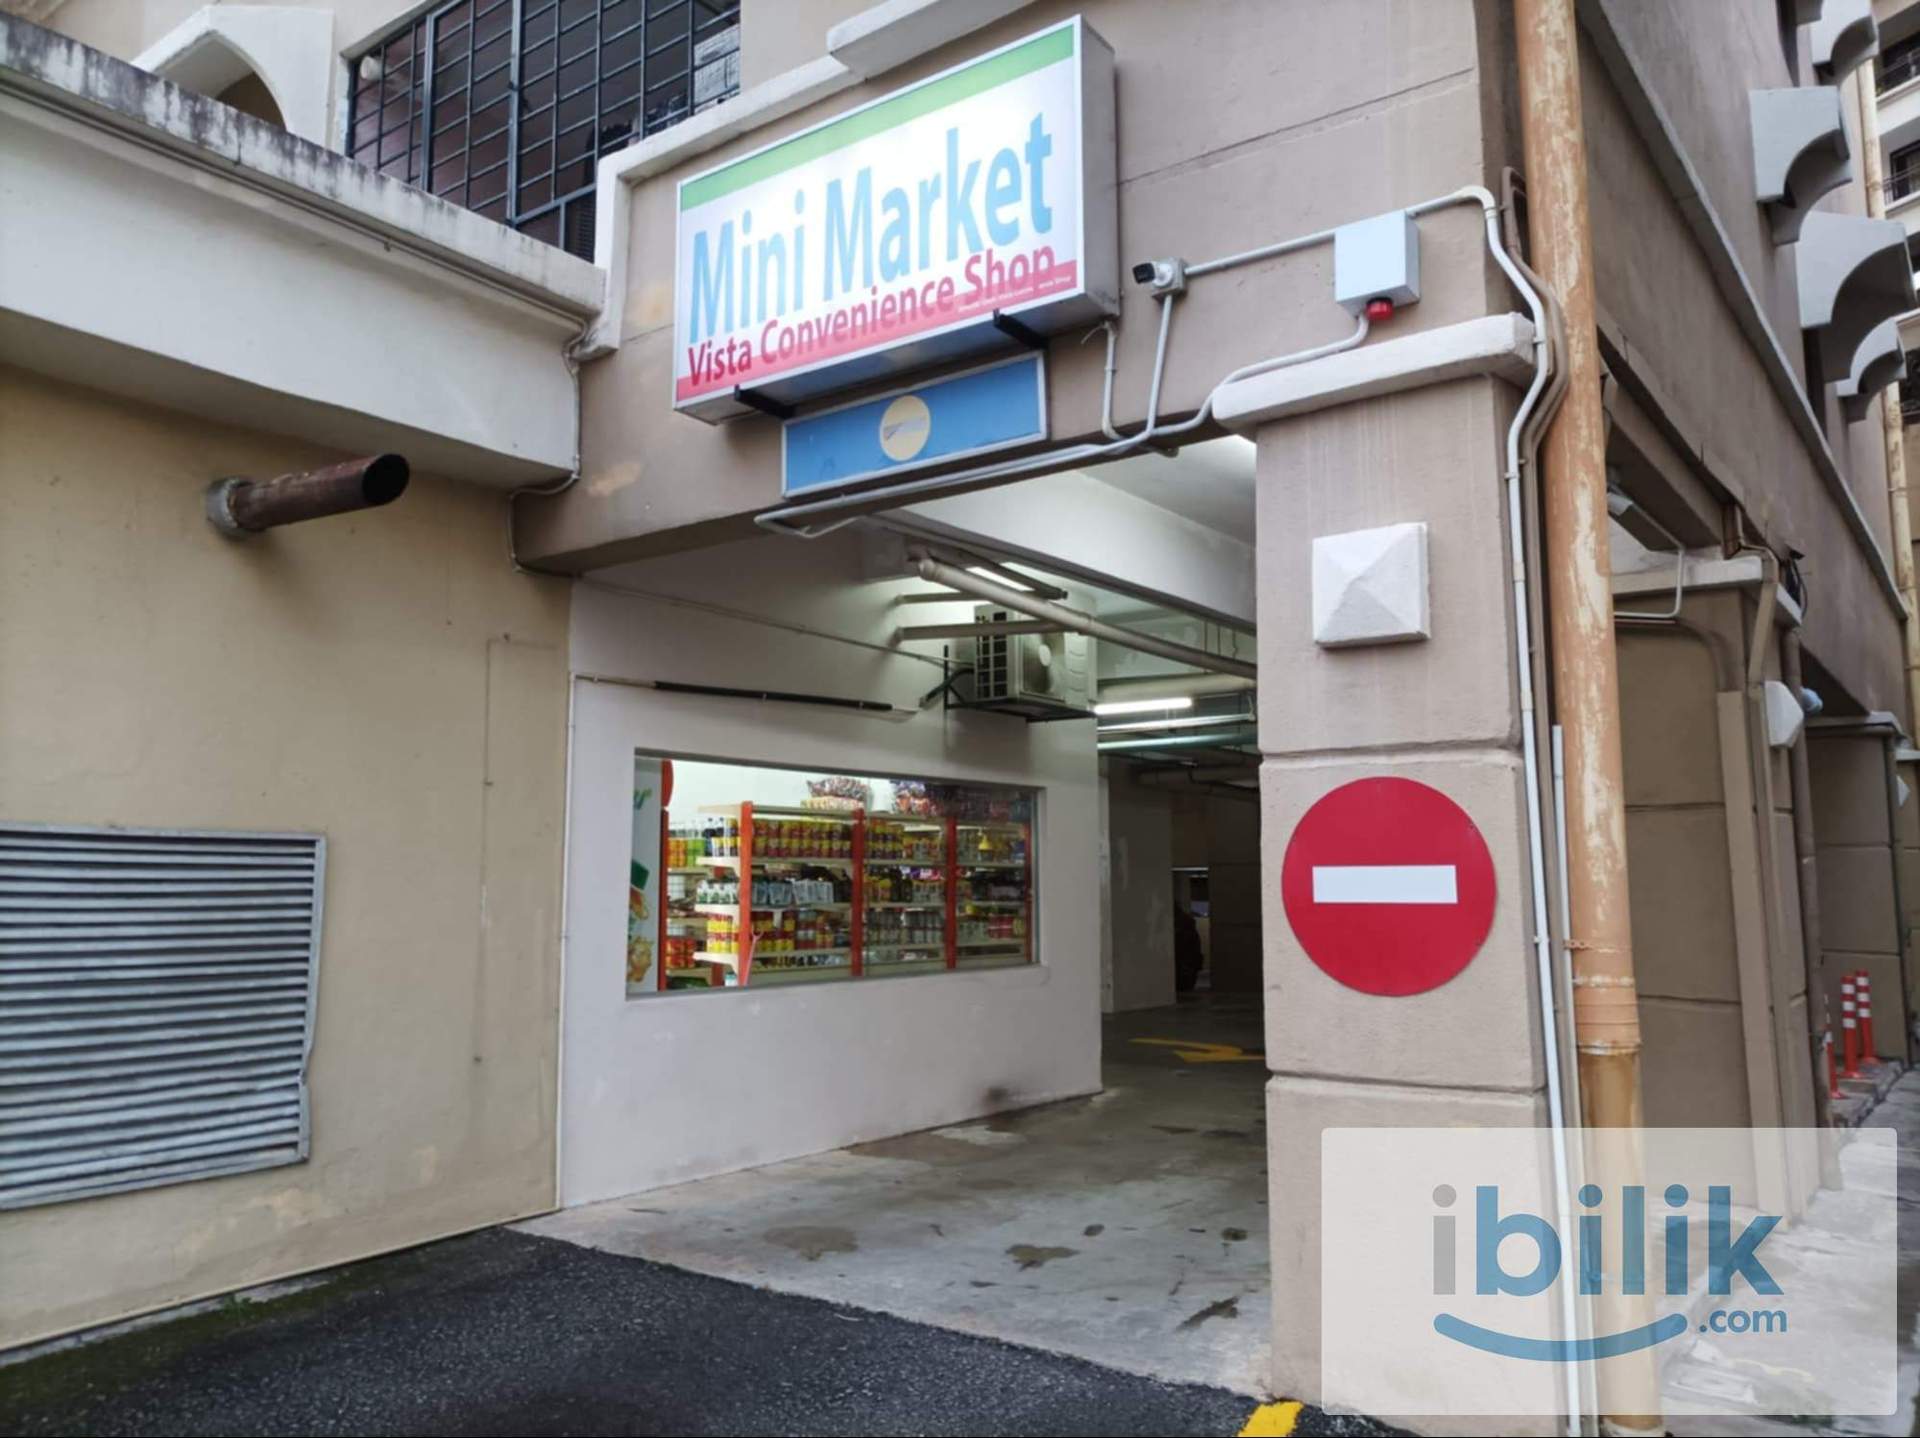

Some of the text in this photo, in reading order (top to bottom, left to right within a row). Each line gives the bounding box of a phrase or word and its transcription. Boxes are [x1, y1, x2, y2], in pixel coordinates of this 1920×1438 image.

[688, 337, 753, 387] Vista
[760, 276, 955, 365] Convenience
[964, 245, 1055, 306] Shop
[689, 112, 1053, 344] Mini Market
